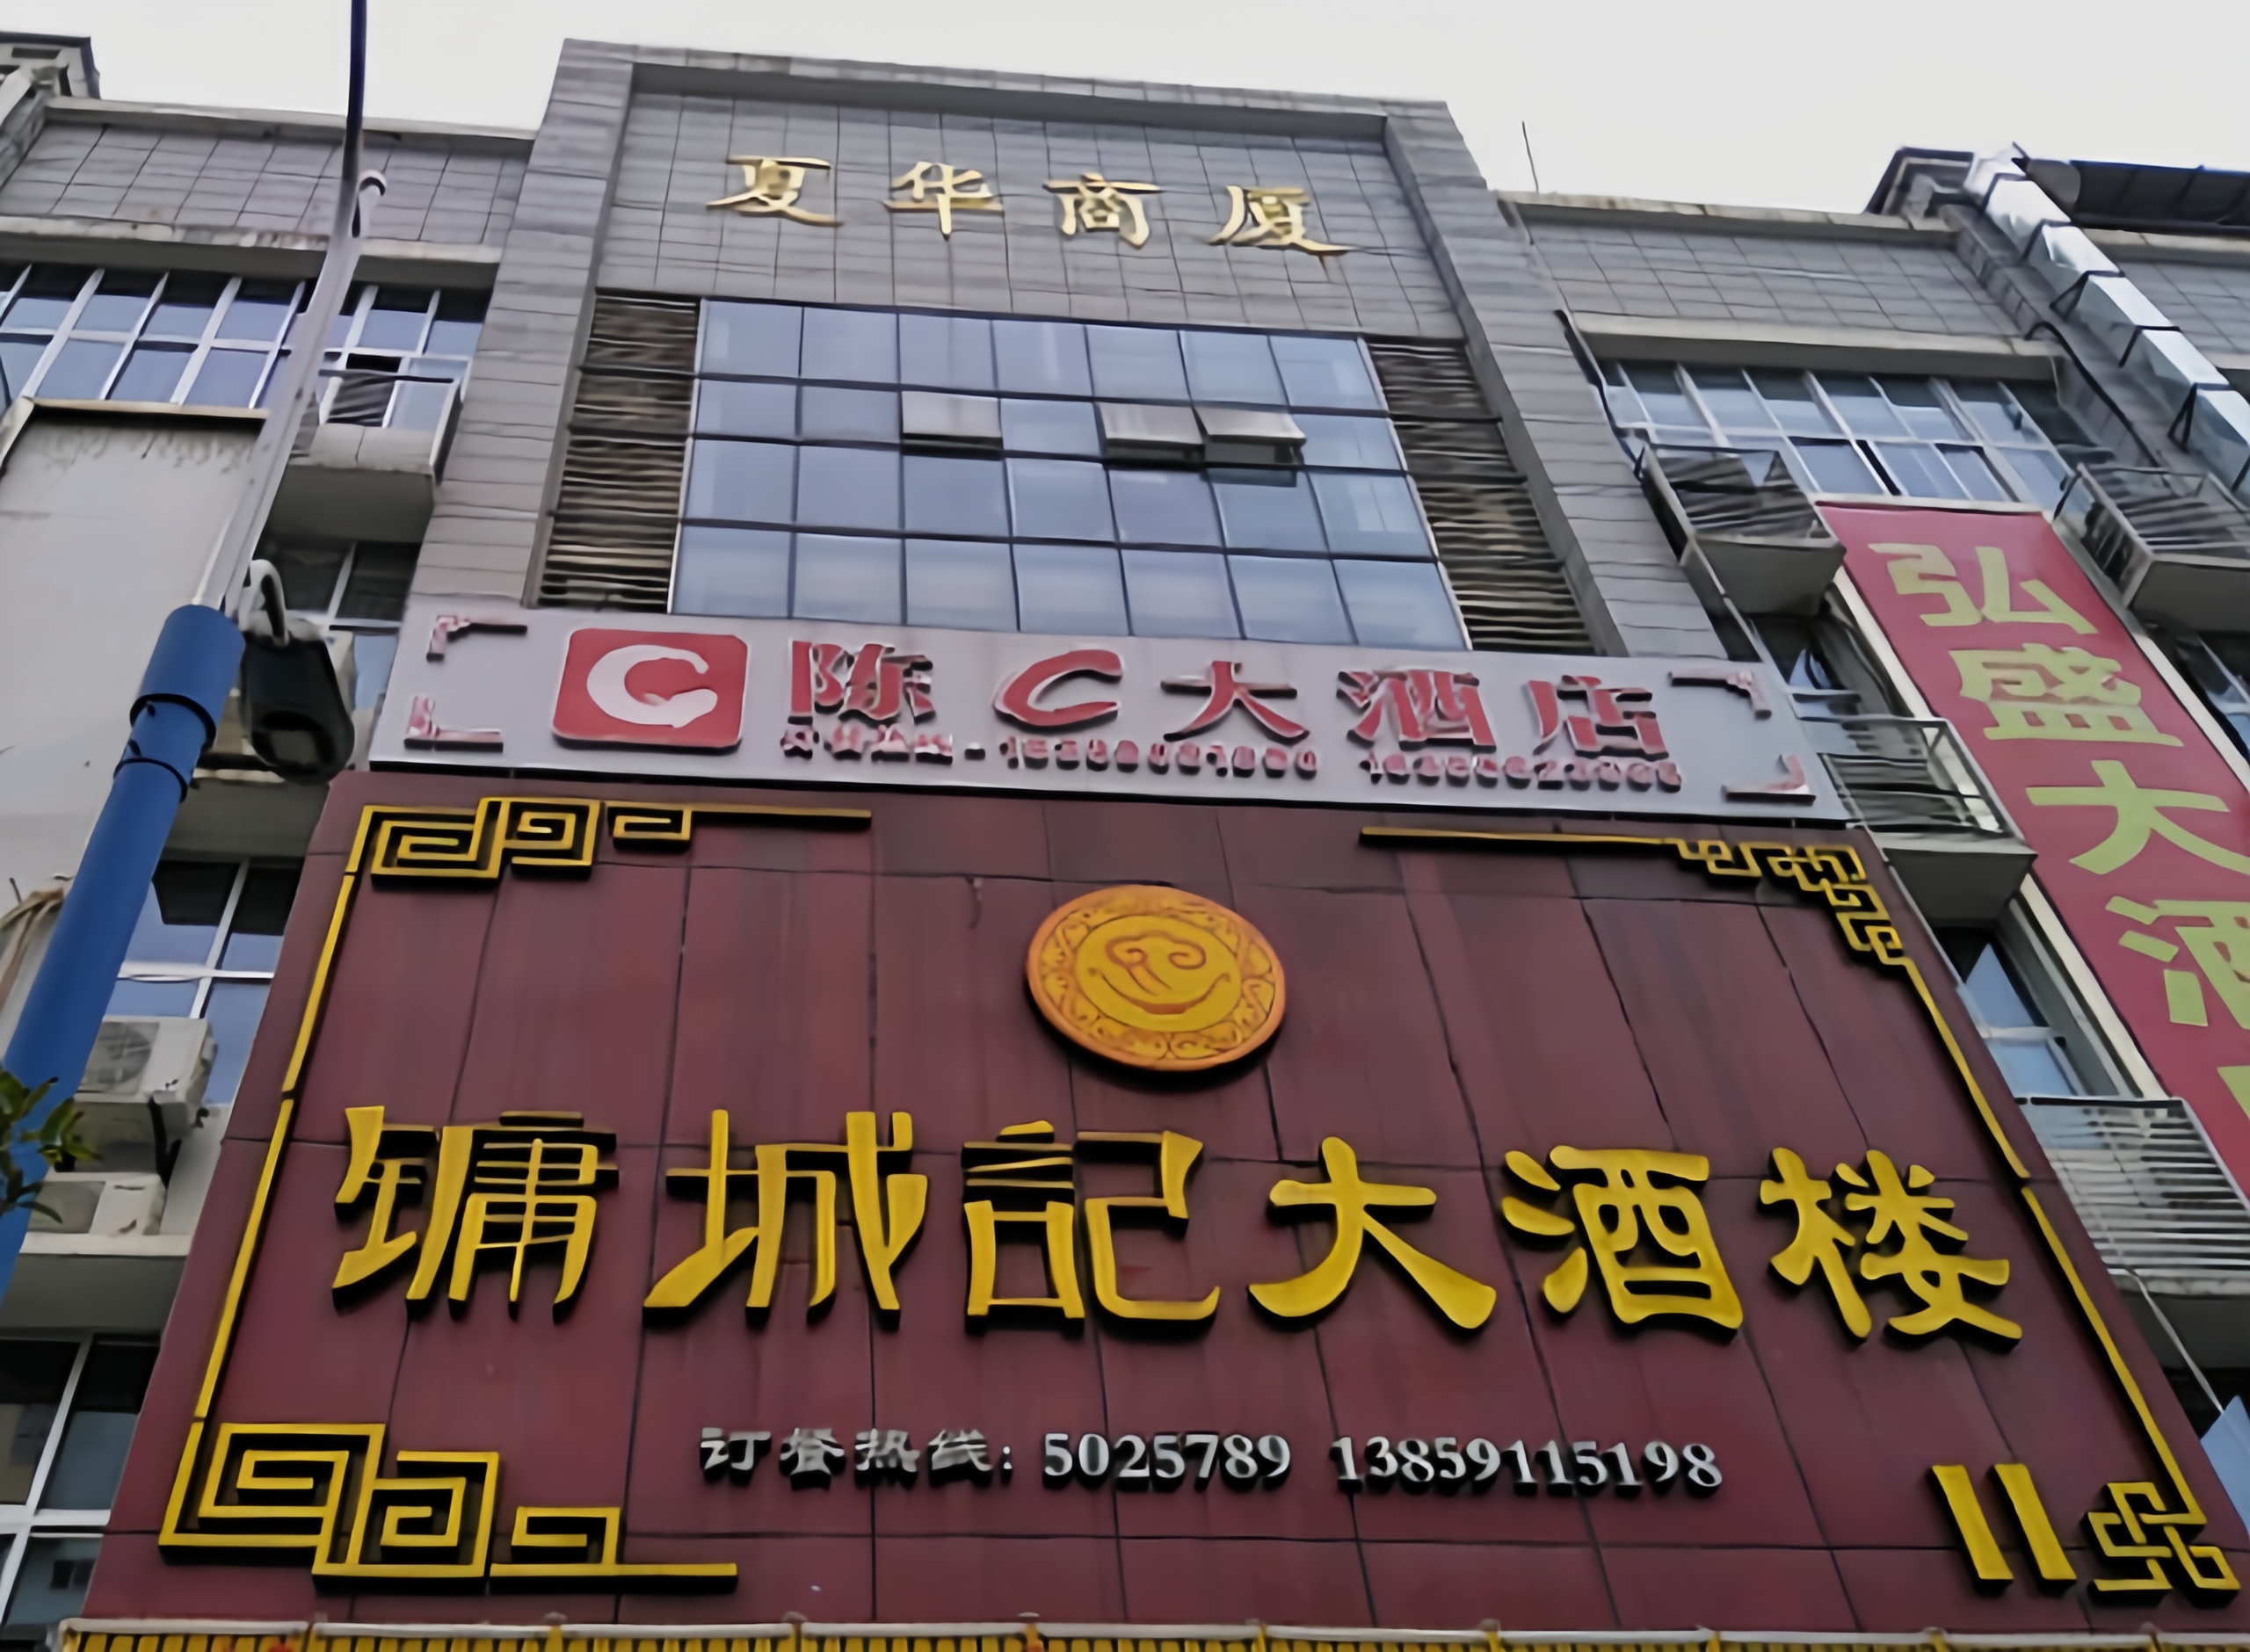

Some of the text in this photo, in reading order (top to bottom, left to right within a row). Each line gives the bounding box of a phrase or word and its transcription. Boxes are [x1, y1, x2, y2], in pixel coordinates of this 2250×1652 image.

[707, 154, 1354, 257] 夏华商厦
[1869, 541, 2250, 1121] 弘盛大酒
[1043, 1432, 1291, 1480] 5025789
[1332, 1436, 1724, 1488] 13859115198
